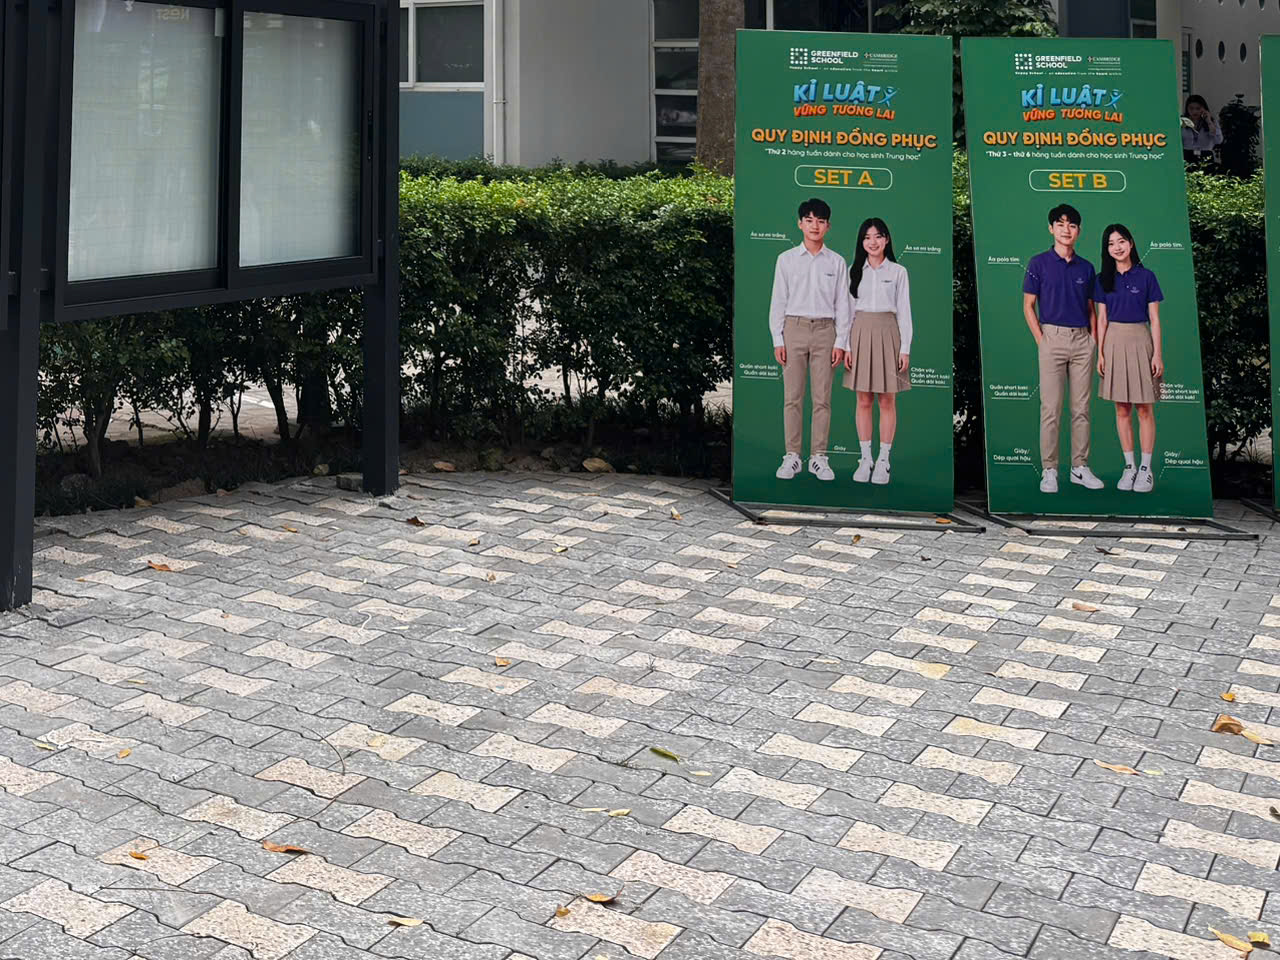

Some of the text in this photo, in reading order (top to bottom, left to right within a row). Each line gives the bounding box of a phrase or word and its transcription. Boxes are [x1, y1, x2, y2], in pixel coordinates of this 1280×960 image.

[811, 50, 858, 58] GREENFIELD
[823, 80, 880, 104] LUẬT
[1050, 84, 1107, 108] LUẬT
[832, 104, 874, 117] TƯƠNG
[876, 108, 896, 120] LAI
[1061, 108, 1102, 120] TƯƠNG
[1104, 111, 1123, 122] LAI
[751, 127, 937, 151] QUY ĐỊNH ĐỒNG PHỤC
[983, 128, 1167, 150] QUY ĐỊNH ĐỒNG PHỤC
[856, 151, 869, 159] học
[886, 152, 904, 161] Trung
[1129, 152, 1148, 160] Trung
[814, 168, 874, 186] SET A
[1048, 172, 1108, 188] SET B
